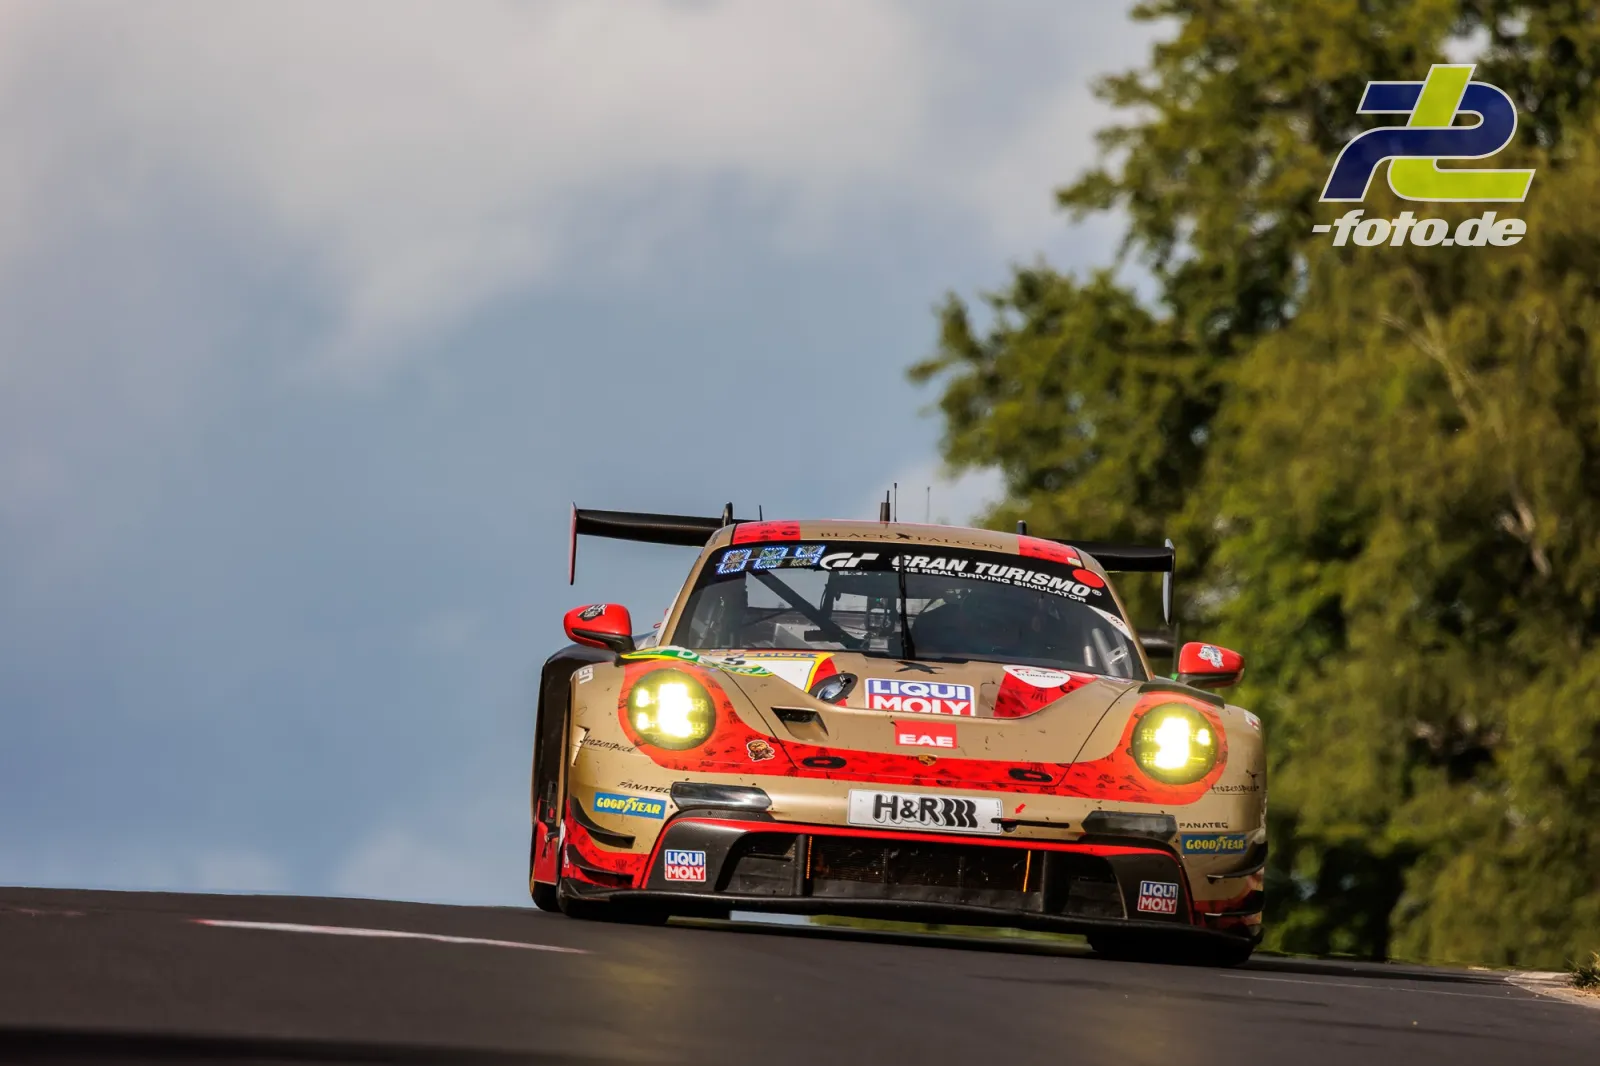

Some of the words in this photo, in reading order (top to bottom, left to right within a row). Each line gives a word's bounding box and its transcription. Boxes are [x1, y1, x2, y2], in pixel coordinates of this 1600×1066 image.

[917, 536, 1003, 549] FALCON
[891, 554, 968, 572] GRAN
[921, 568, 955, 577] REAL
[958, 572, 1011, 584] DRIVING
[1013, 580, 1086, 603] SIMULATOR
[873, 680, 966, 699] LIQUI
[873, 695, 969, 717] MOLY
[899, 733, 954, 748] EAE
[617, 781, 671, 794] FANATEC
[596, 797, 662, 815] GOODYEAR
[873, 793, 944, 826] H&R
[1185, 836, 1244, 852] GOODYEAR
[667, 851, 703, 867] LIQUI
[667, 866, 704, 880] MOLY
[1141, 882, 1177, 898] LIQUI
[1140, 897, 1177, 912] MOLY
